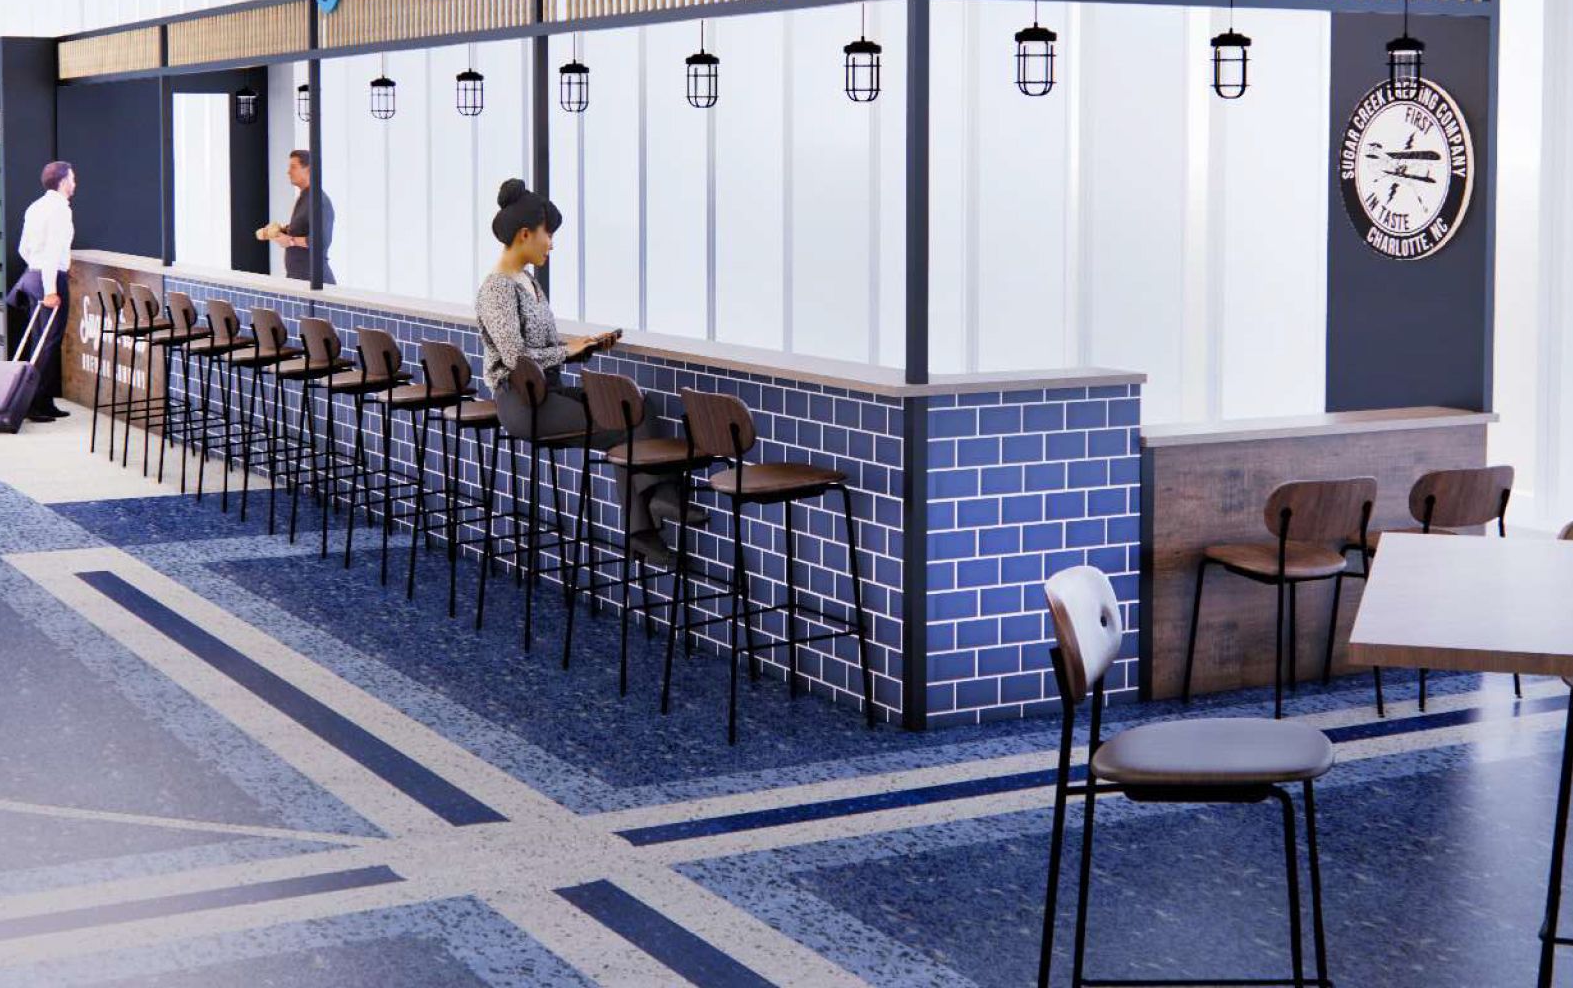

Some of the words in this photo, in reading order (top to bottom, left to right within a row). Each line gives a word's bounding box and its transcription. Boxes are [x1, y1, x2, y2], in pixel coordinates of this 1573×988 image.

[1341, 129, 1360, 180] SUGAR
[1353, 87, 1387, 130] CREEK
[1436, 103, 1467, 178] COMPANY
[1405, 107, 1434, 134] FIRST
[1365, 192, 1379, 211] IN
[1378, 205, 1410, 231] TASTE
[1430, 217, 1449, 241] NC
